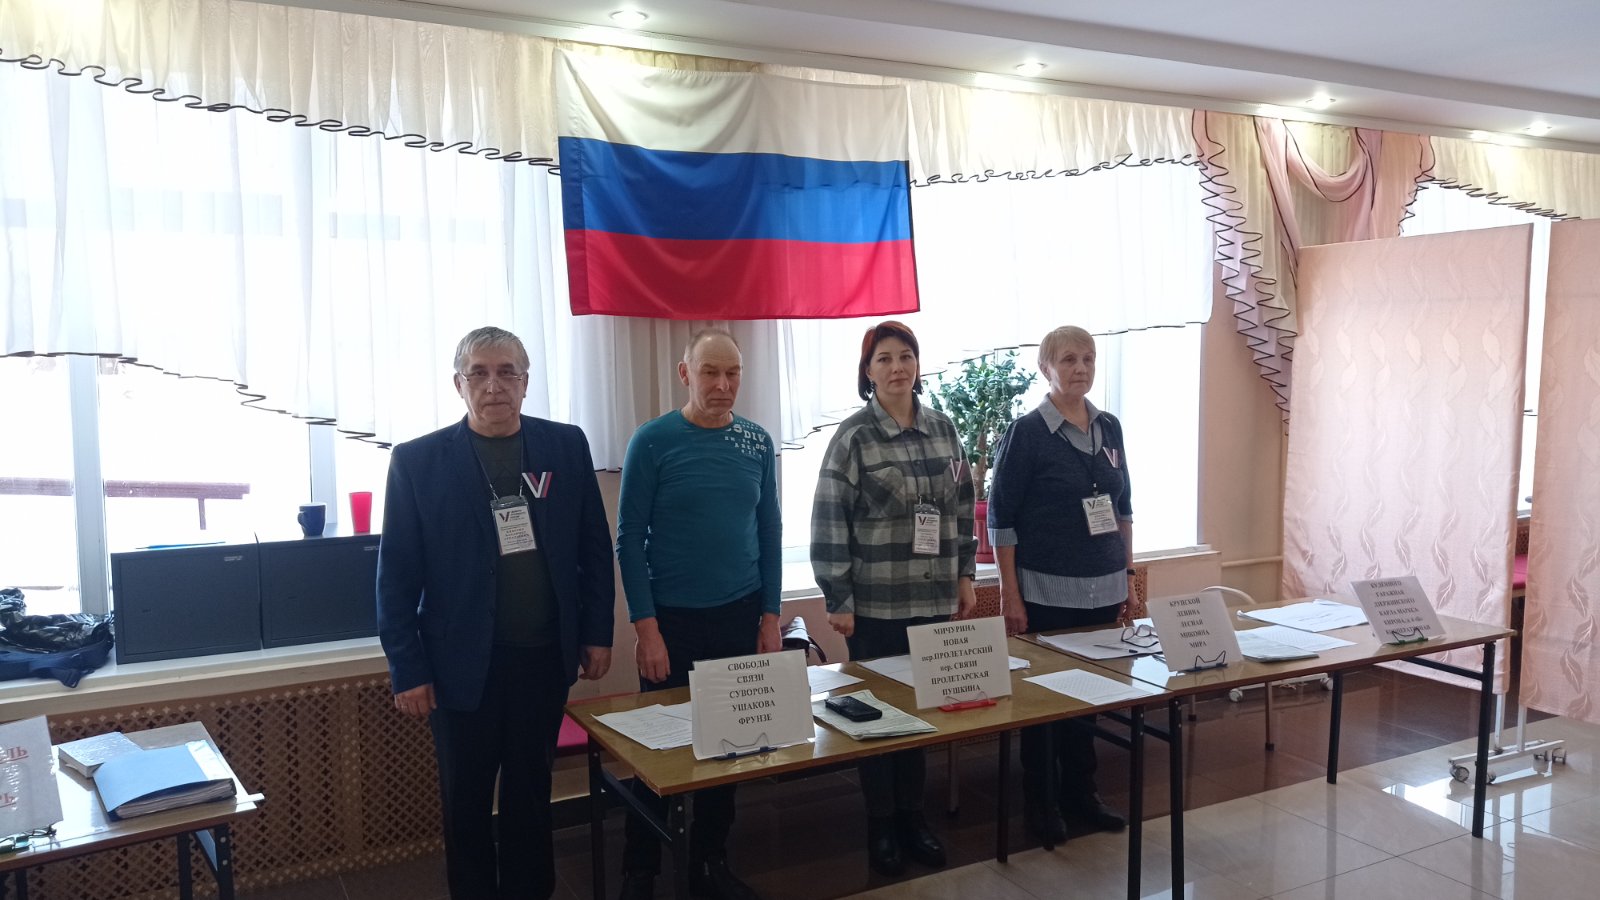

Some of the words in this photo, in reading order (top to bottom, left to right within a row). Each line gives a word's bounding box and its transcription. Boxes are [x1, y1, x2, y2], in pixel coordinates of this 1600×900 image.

[1177, 609, 1200, 617] ЛЕНИНА
[933, 624, 976, 635] МИЧУРИНА
[943, 637, 969, 647] НОВАЯ
[1189, 640, 1207, 648] МИРА
[727, 659, 770, 672] СВОБОДЫ
[953, 660, 978, 670] СВЯЗИ
[736, 673, 764, 684] СВЯЗИ
[931, 670, 989, 685] ПРОЛЕТАРСКАЯ
[729, 686, 775, 699] СУВОРОВА
[942, 684, 981, 696] ПУШКИНА
[732, 700, 776, 712] УШАКОВА
[738, 713, 772, 725] ФРУНЗЕ
